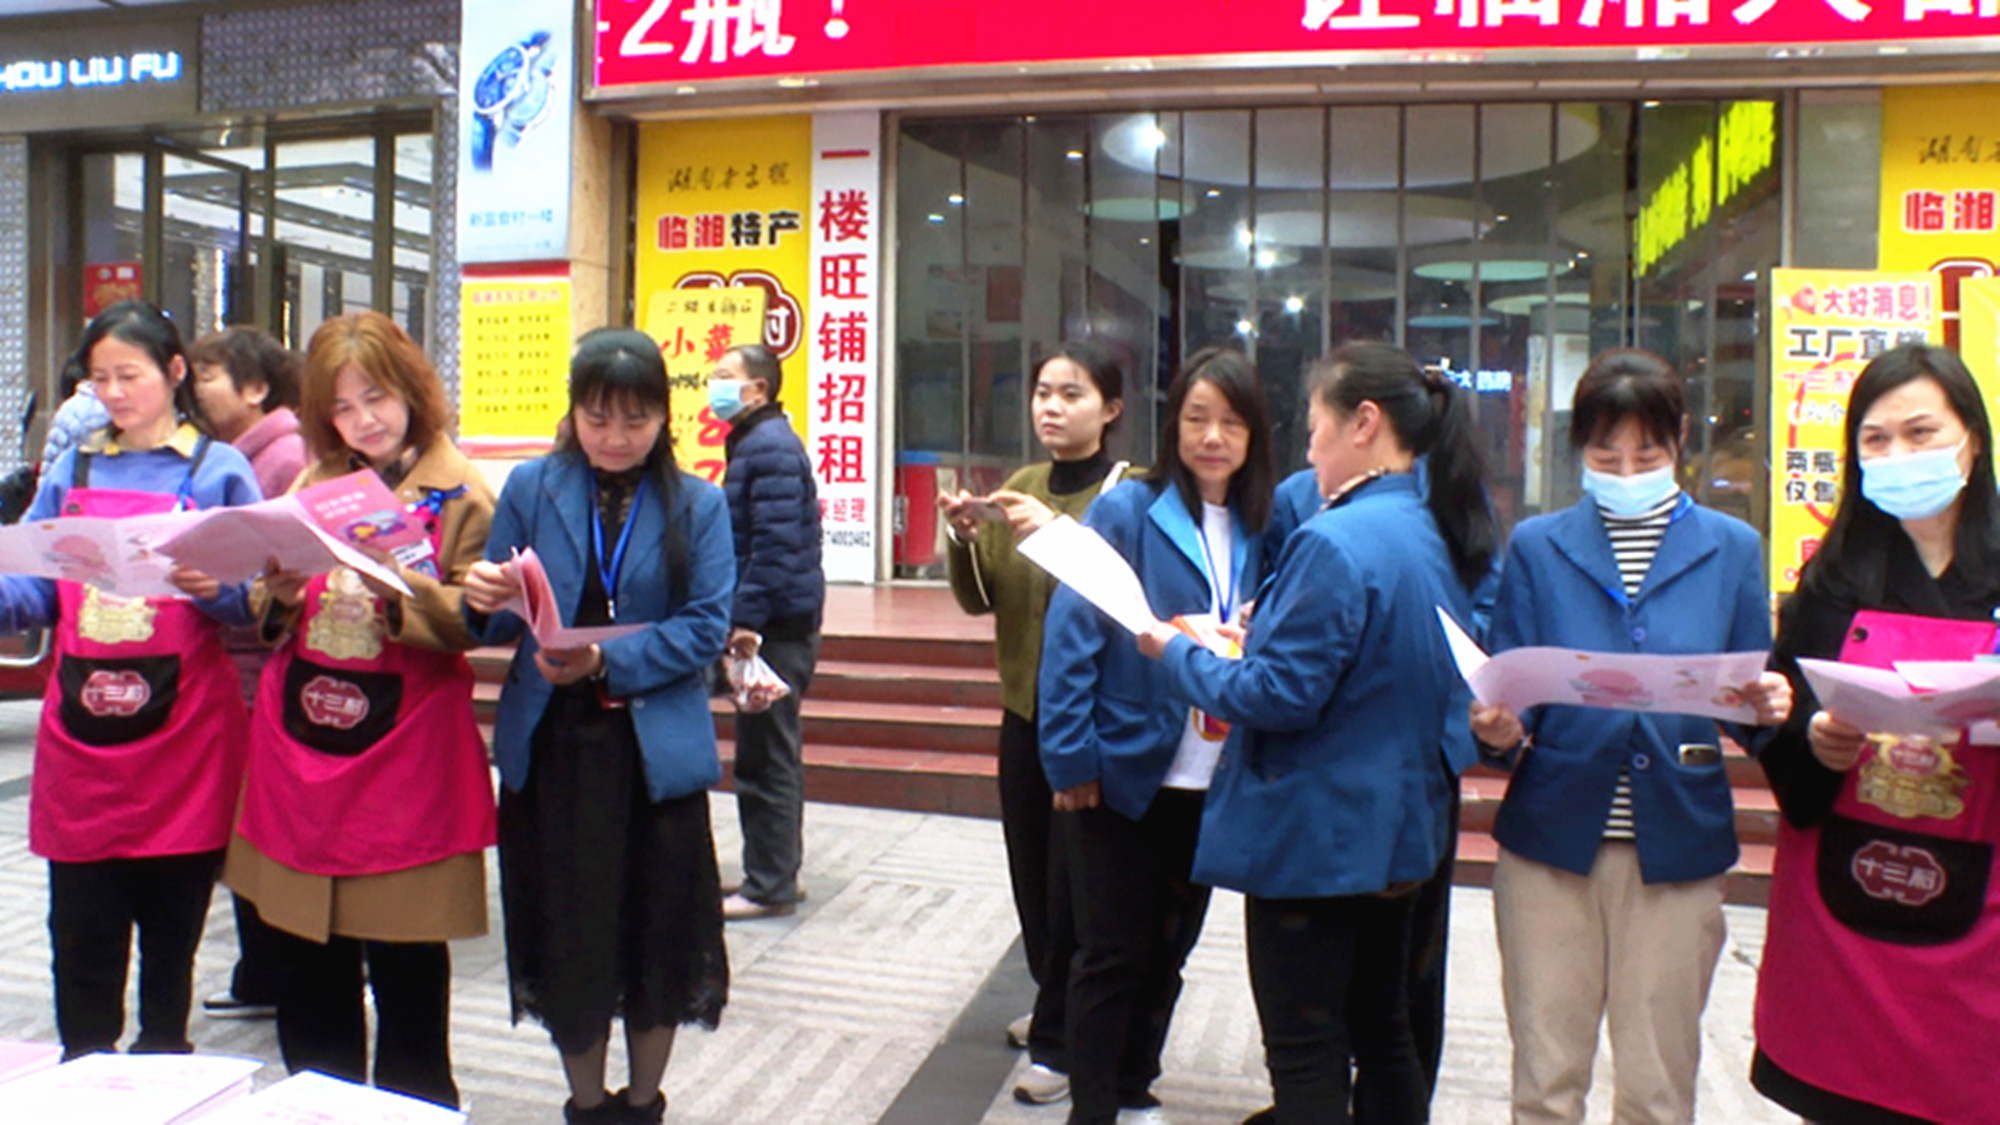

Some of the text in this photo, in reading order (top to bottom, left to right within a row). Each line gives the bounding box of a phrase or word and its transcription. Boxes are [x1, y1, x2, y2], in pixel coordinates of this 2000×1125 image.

[68, 55, 127, 86] LIU
[130, 51, 182, 82] FU
[658, 211, 800, 250] 临湘特产
[1905, 191, 1996, 231] 临湘
[818, 149, 871, 488] 一楼旺铺招租
[1823, 283, 1931, 322] 大好消息！
